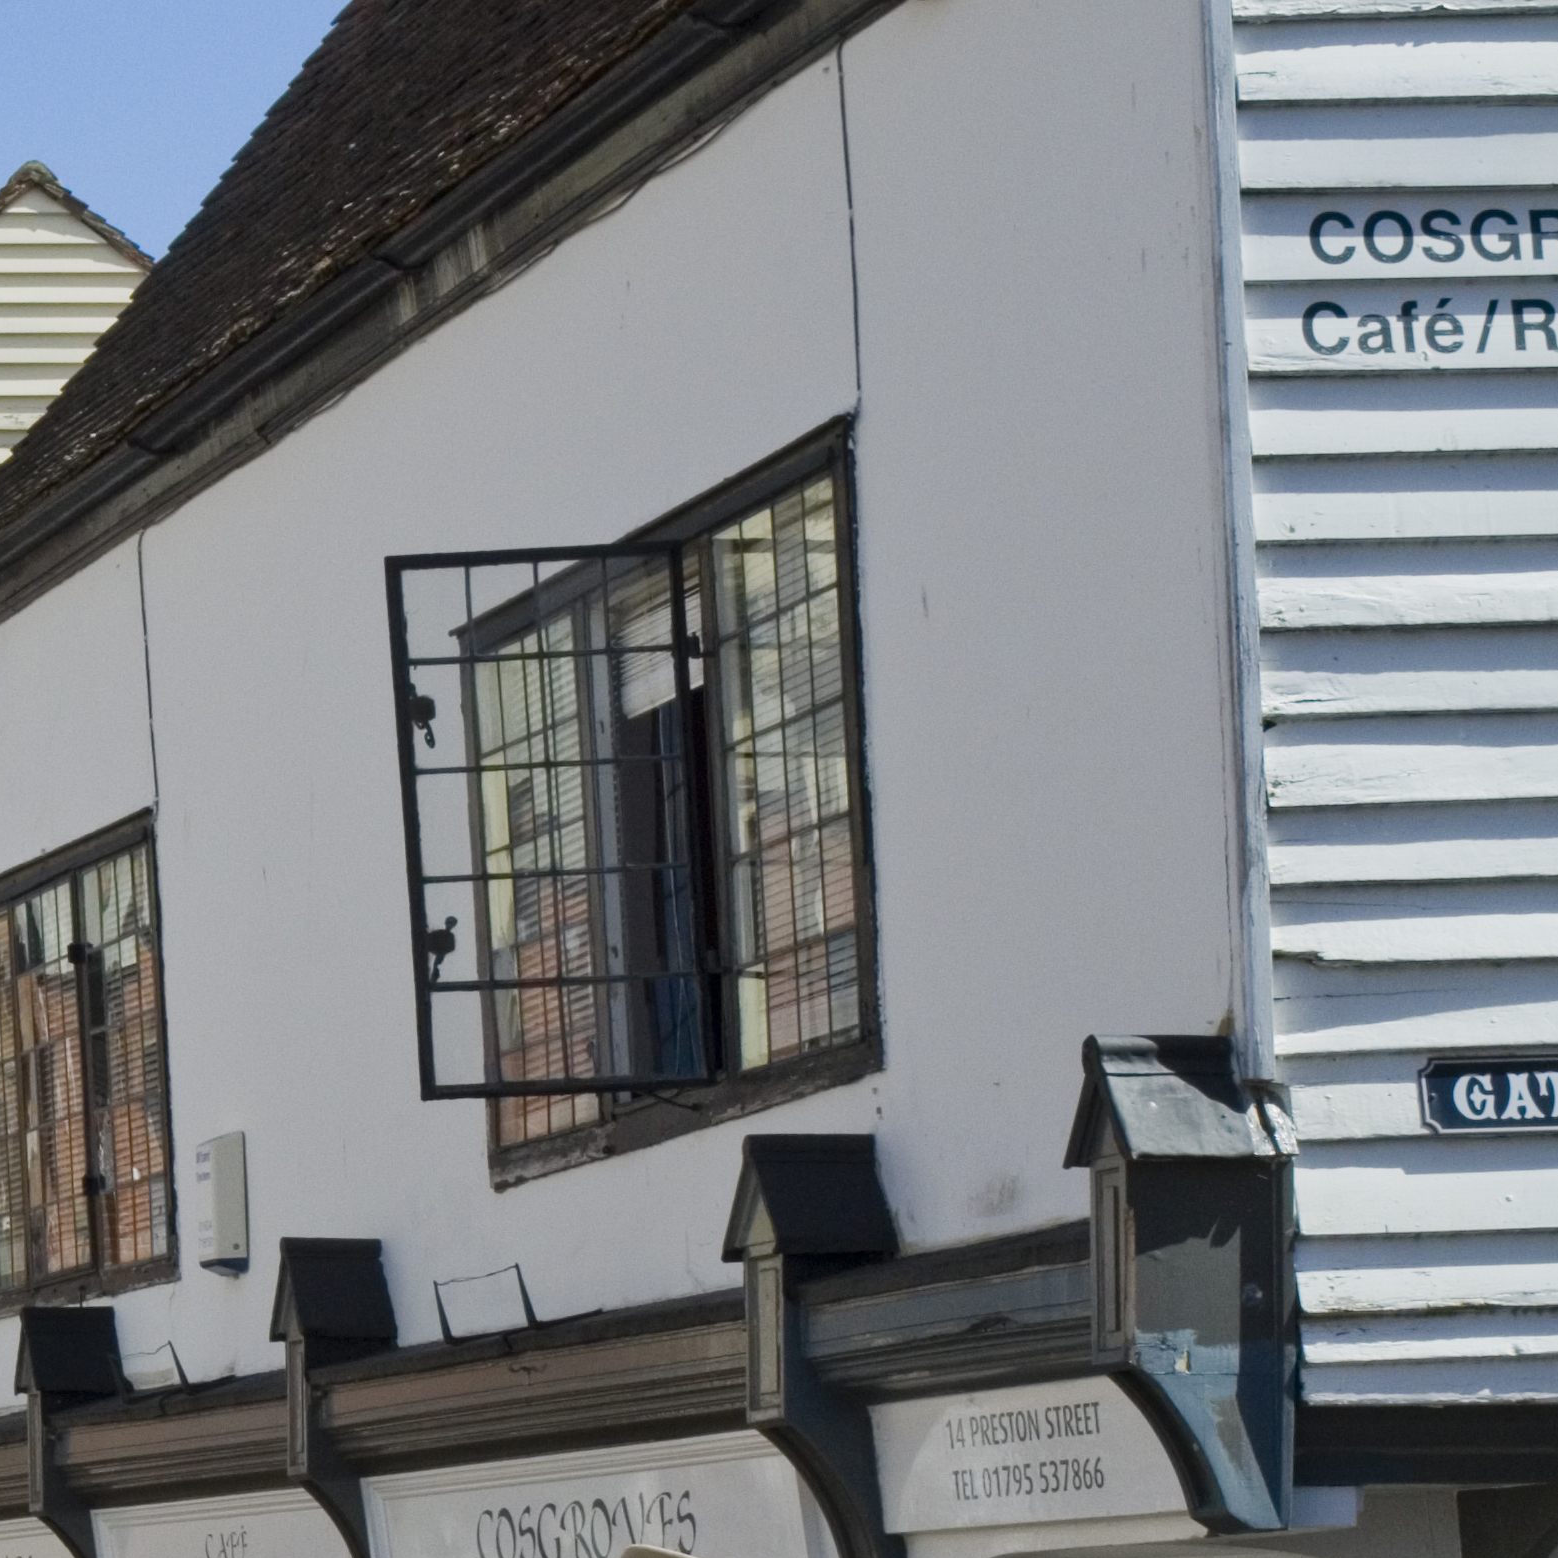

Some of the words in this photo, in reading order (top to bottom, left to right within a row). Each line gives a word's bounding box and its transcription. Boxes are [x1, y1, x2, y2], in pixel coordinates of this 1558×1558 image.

[945, 1418, 966, 1450] 14
[969, 1407, 1041, 1448] PRESTON
[1043, 1401, 1102, 1441] STREET
[952, 1469, 979, 1501] TEL
[981, 1462, 1034, 1500] 01795
[1039, 1456, 1105, 1493] 537866
